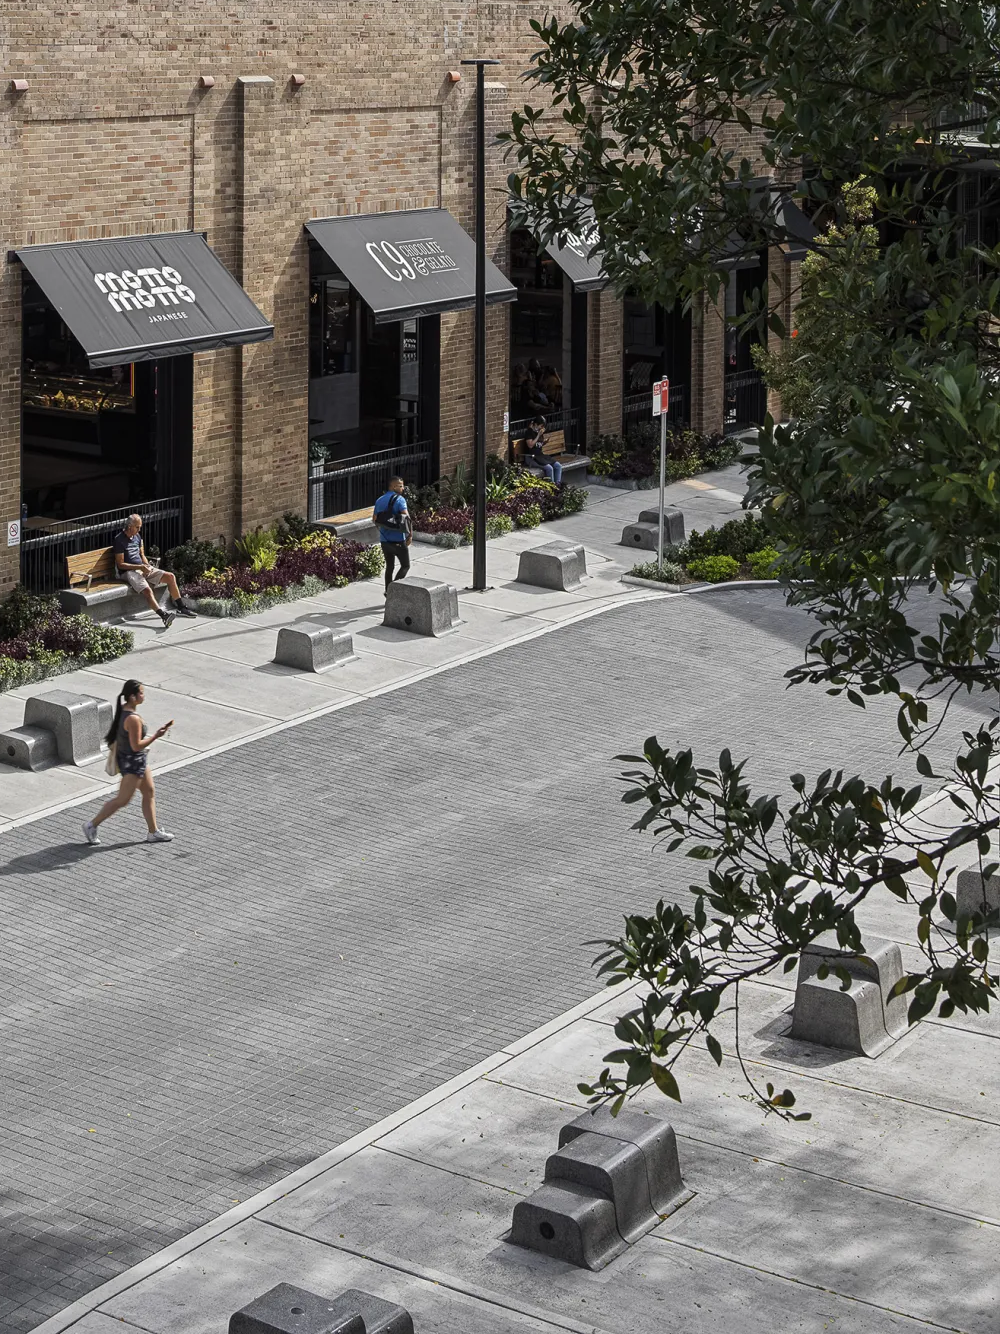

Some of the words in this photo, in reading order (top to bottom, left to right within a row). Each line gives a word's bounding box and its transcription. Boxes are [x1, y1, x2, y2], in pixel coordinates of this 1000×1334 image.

[399, 241, 444, 258] CHOCOLATE
[366, 240, 416, 282] C9
[412, 256, 429, 275] &
[424, 255, 456, 270] GELATO
[149, 311, 188, 323] JAPANESE
